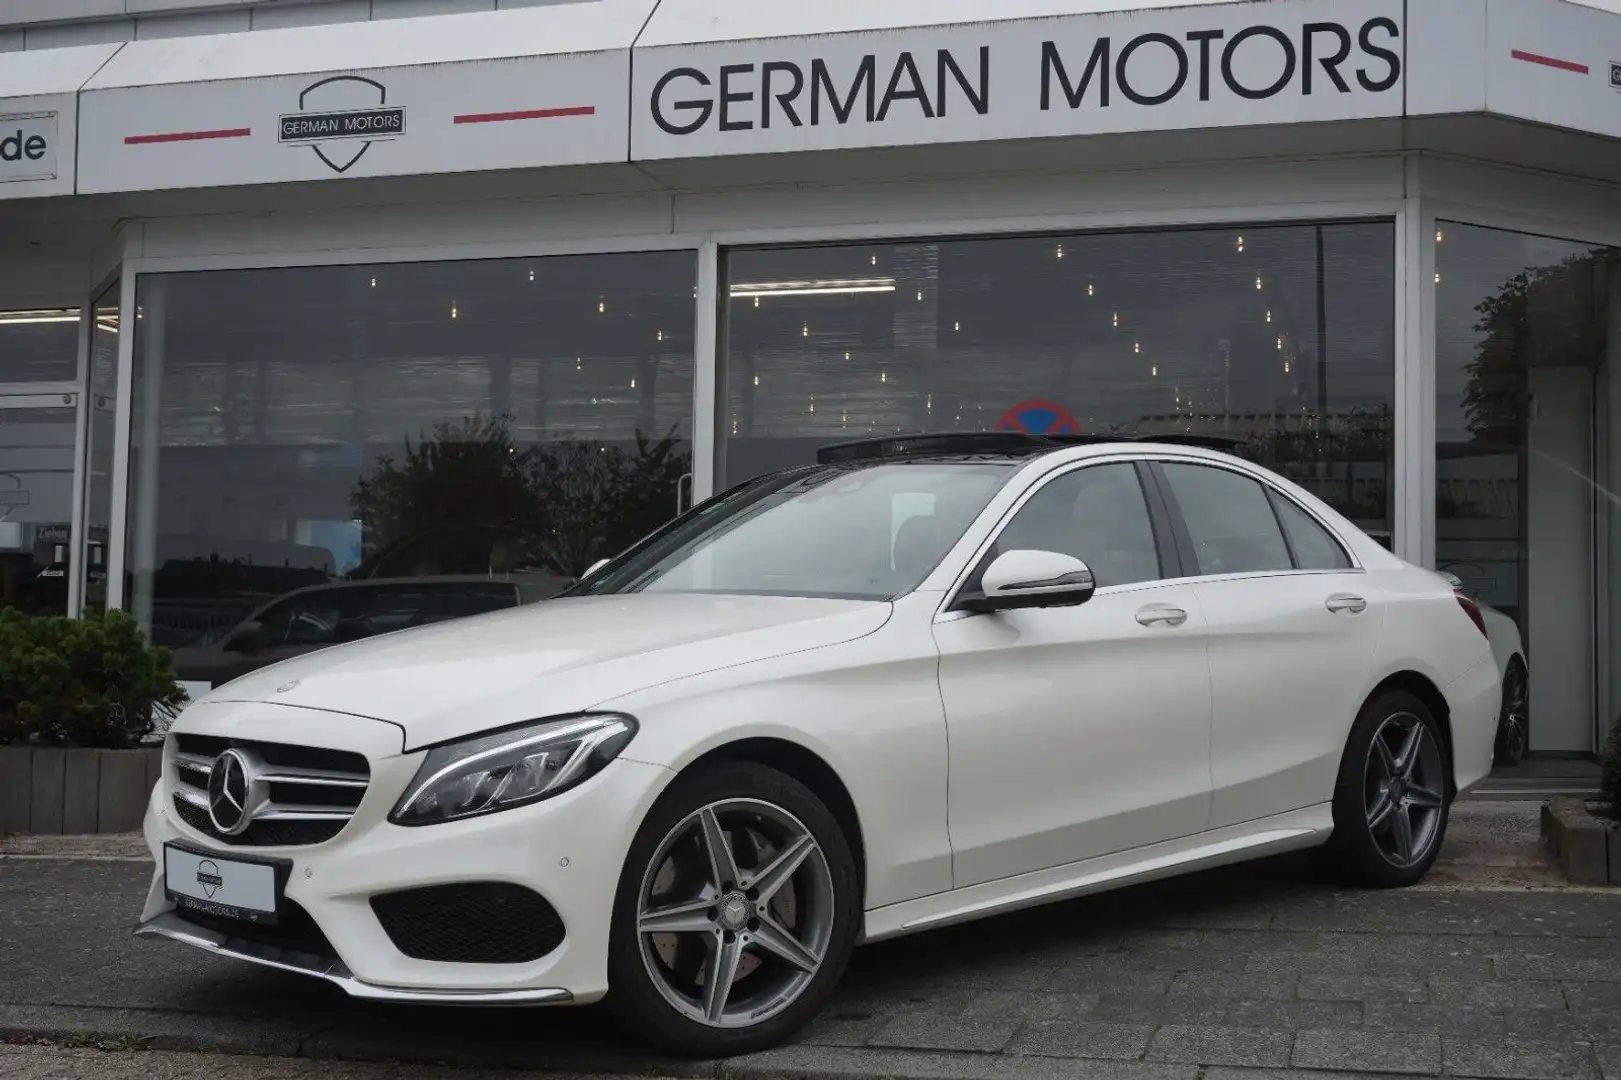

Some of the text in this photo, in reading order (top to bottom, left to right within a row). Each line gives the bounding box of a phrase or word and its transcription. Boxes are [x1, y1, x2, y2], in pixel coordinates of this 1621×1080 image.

[650, 16, 1401, 135] GERMAN MOTORS
[283, 114, 401, 135] GERMAN MOTORS
[0, 129, 47, 162] de
